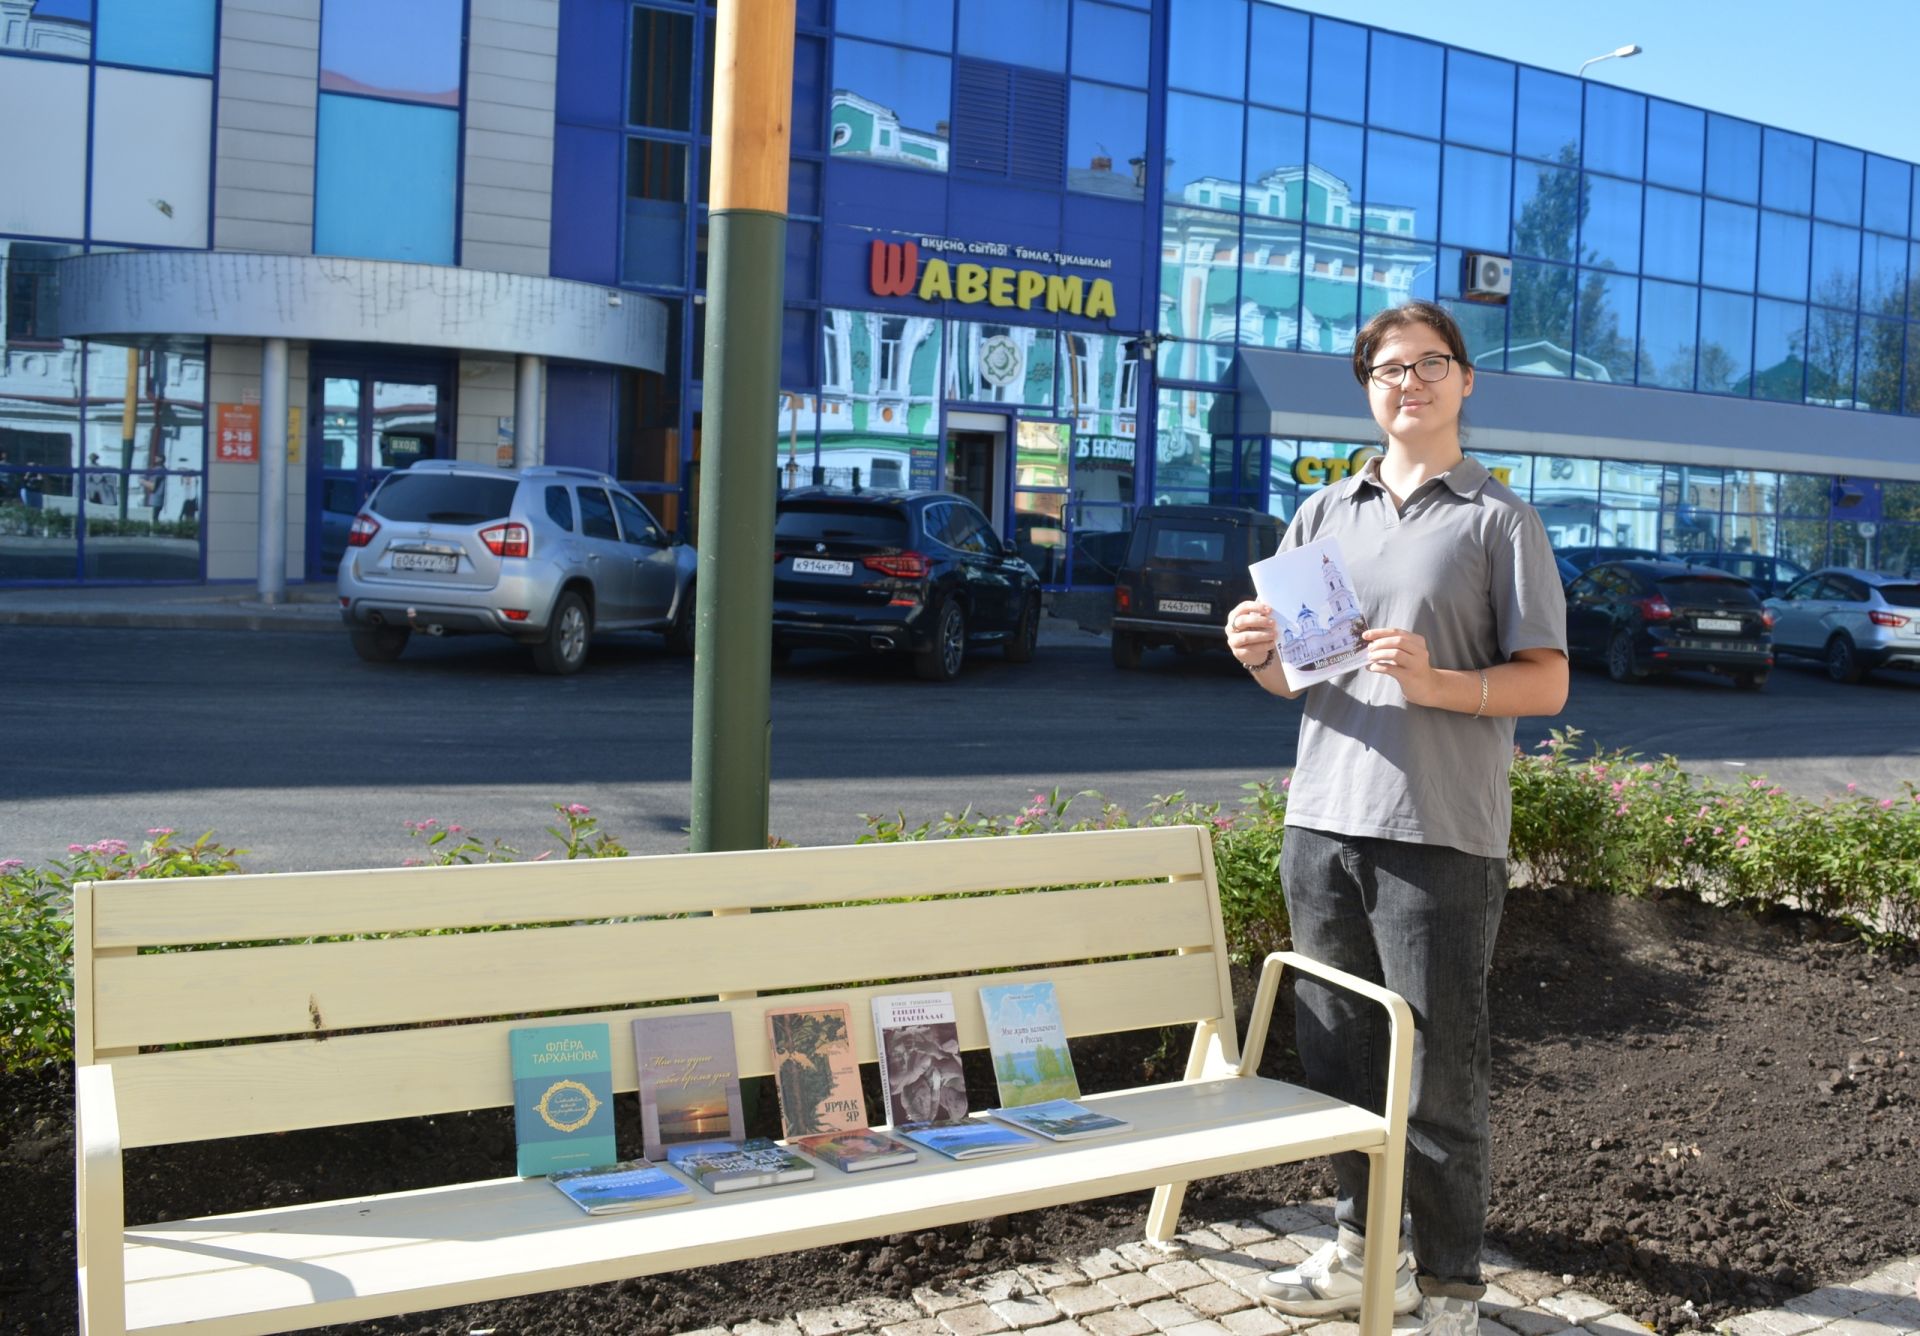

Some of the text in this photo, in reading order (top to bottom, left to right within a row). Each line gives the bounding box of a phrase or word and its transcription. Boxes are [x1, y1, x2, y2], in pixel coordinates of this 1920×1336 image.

[870, 239, 1116, 318] ШАВЕРМА
[391, 439, 418, 451] ВХОД
[545, 1039, 584, 1052] ФЛЁРА
[533, 1050, 598, 1065] ТАРХАНОВА
